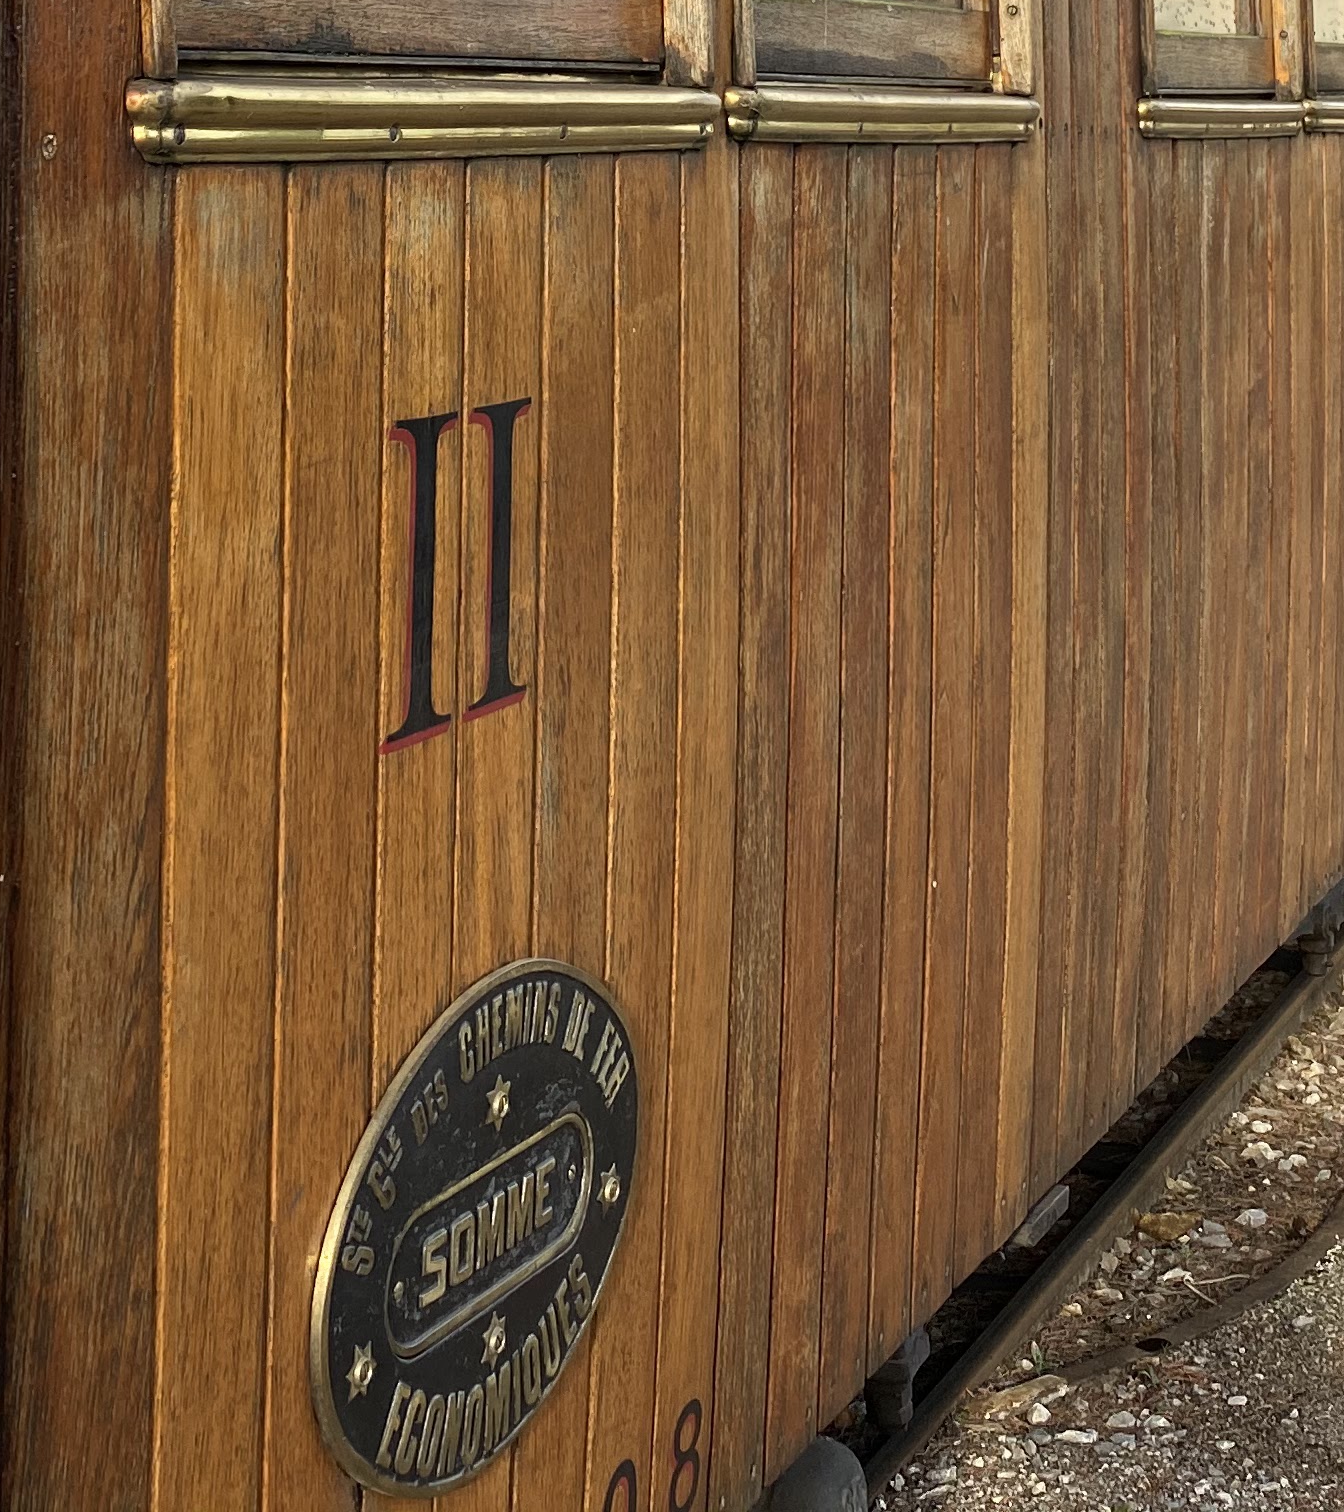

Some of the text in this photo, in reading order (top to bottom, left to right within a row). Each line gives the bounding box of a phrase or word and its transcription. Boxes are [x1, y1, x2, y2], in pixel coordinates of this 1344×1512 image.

[411, 1068, 449, 1146] DES
[459, 980, 562, 1084] CHEMINS
[562, 989, 596, 1061] DE
[590, 1018, 630, 1109] FER
[419, 1156, 555, 1309] SOMME
[375, 1253, 593, 1478] ECONOMIQUES
